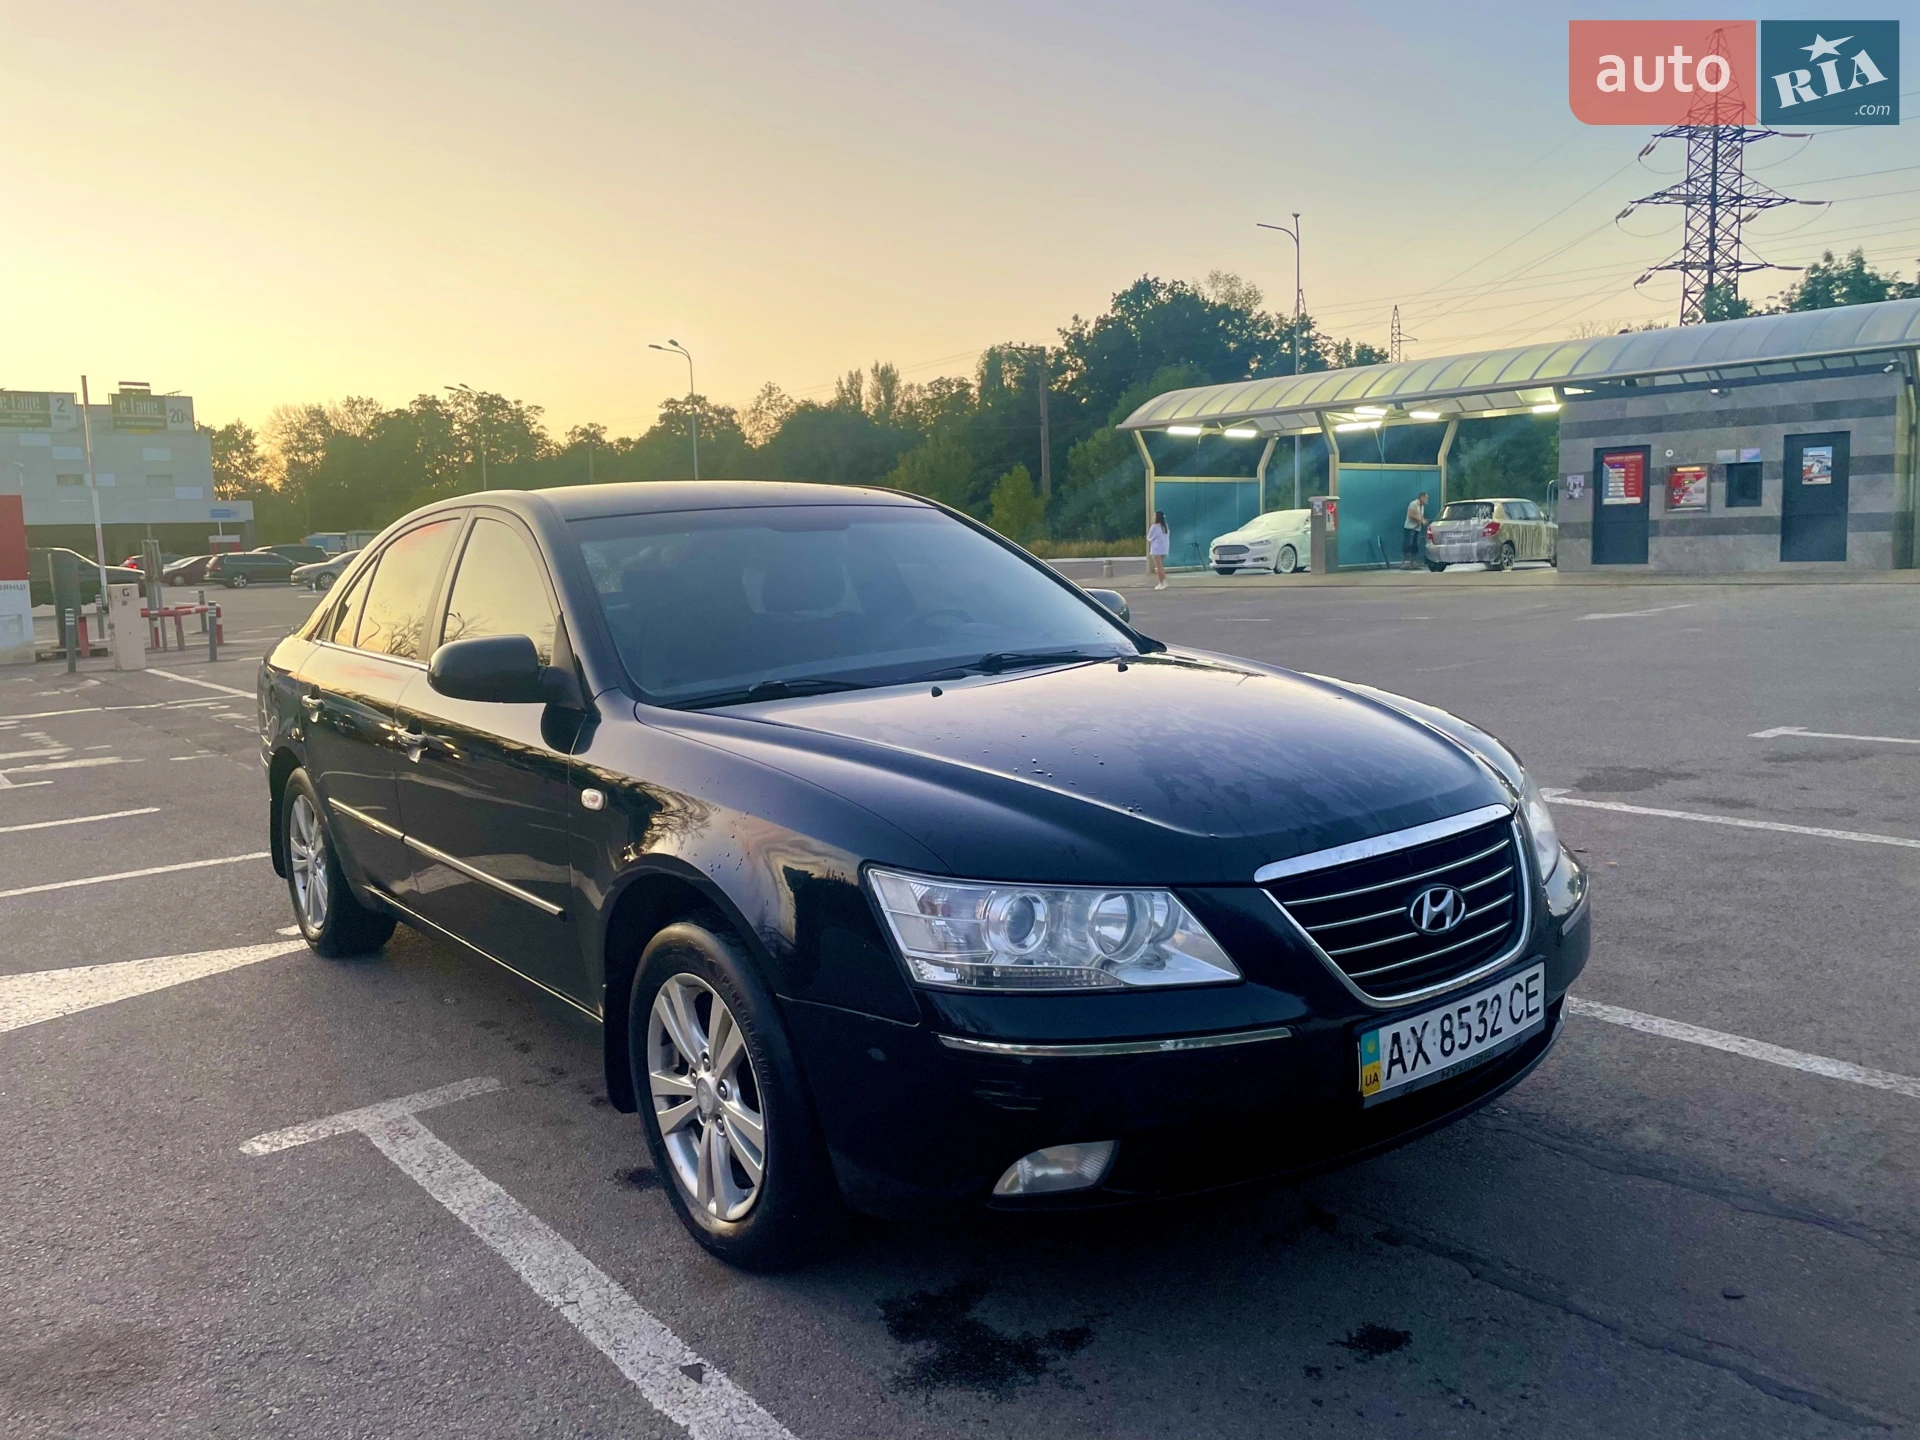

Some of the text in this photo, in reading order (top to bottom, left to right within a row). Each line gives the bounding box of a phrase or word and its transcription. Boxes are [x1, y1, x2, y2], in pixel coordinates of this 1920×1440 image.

[56, 397, 66, 412] 2
[1386, 973, 1540, 1081] AX 8532 CE
[1365, 1074, 1379, 1087] UA
